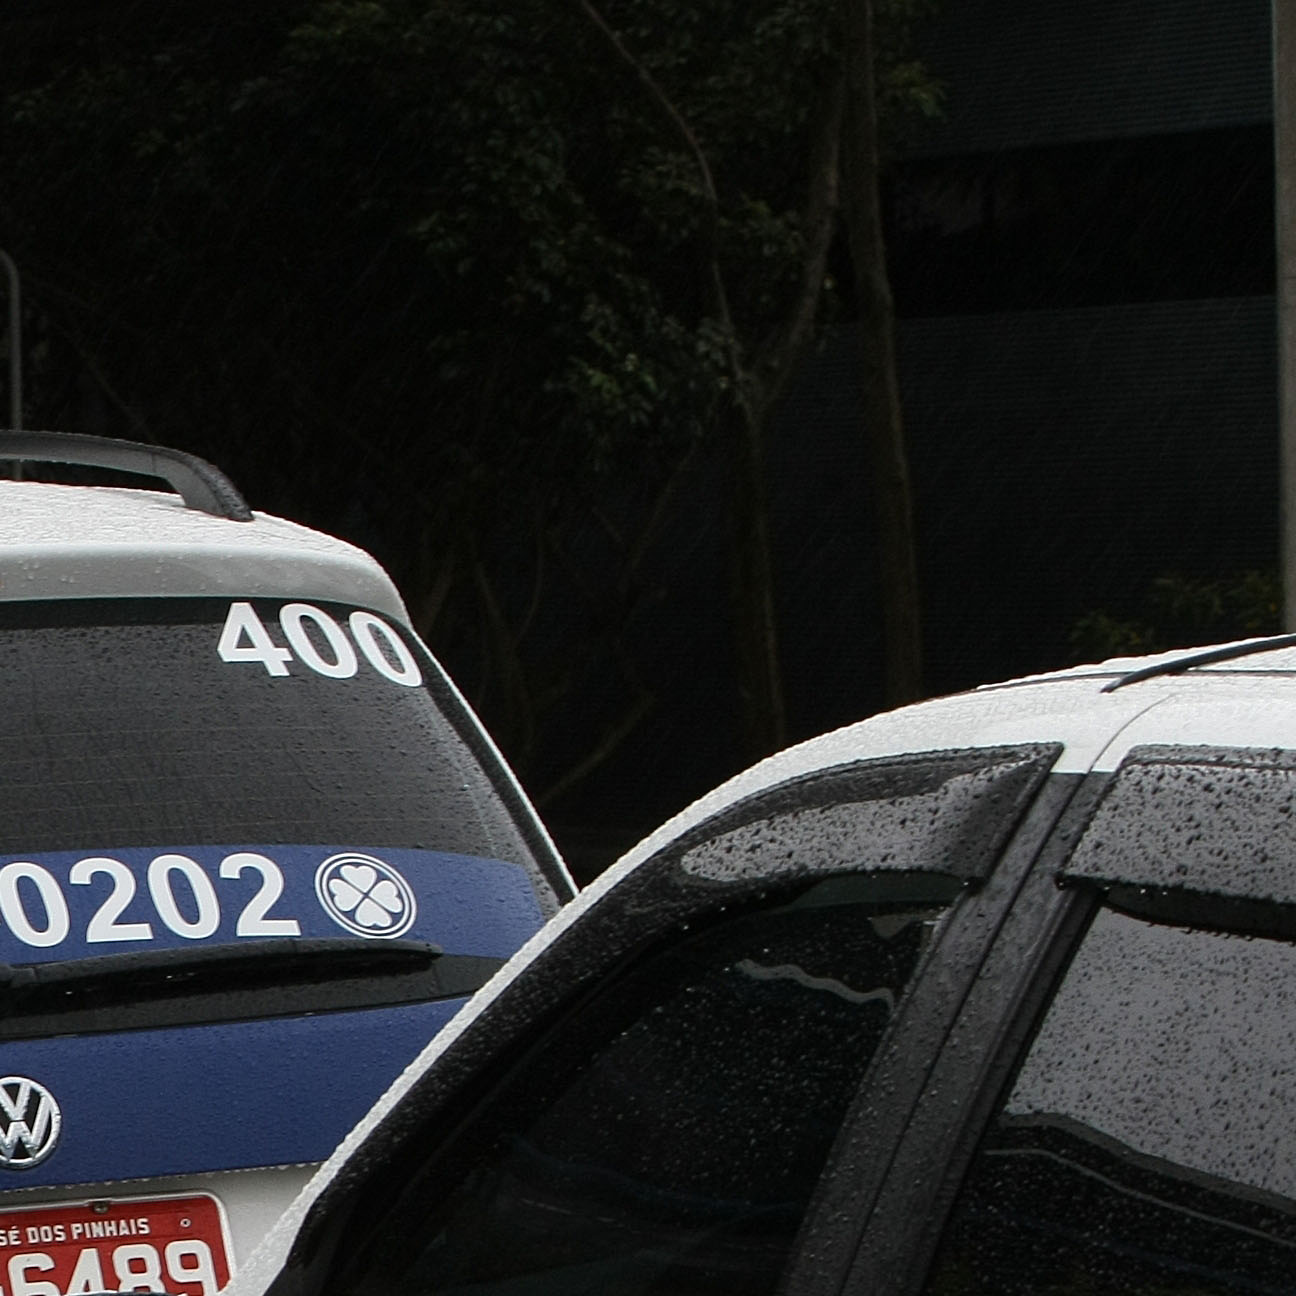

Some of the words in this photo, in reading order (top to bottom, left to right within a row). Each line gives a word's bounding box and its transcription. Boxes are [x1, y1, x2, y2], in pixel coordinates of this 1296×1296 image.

[217, 602, 422, 687] 400
[27, 1224, 67, 1244] DOS
[71, 1218, 151, 1240] PINHAIS
